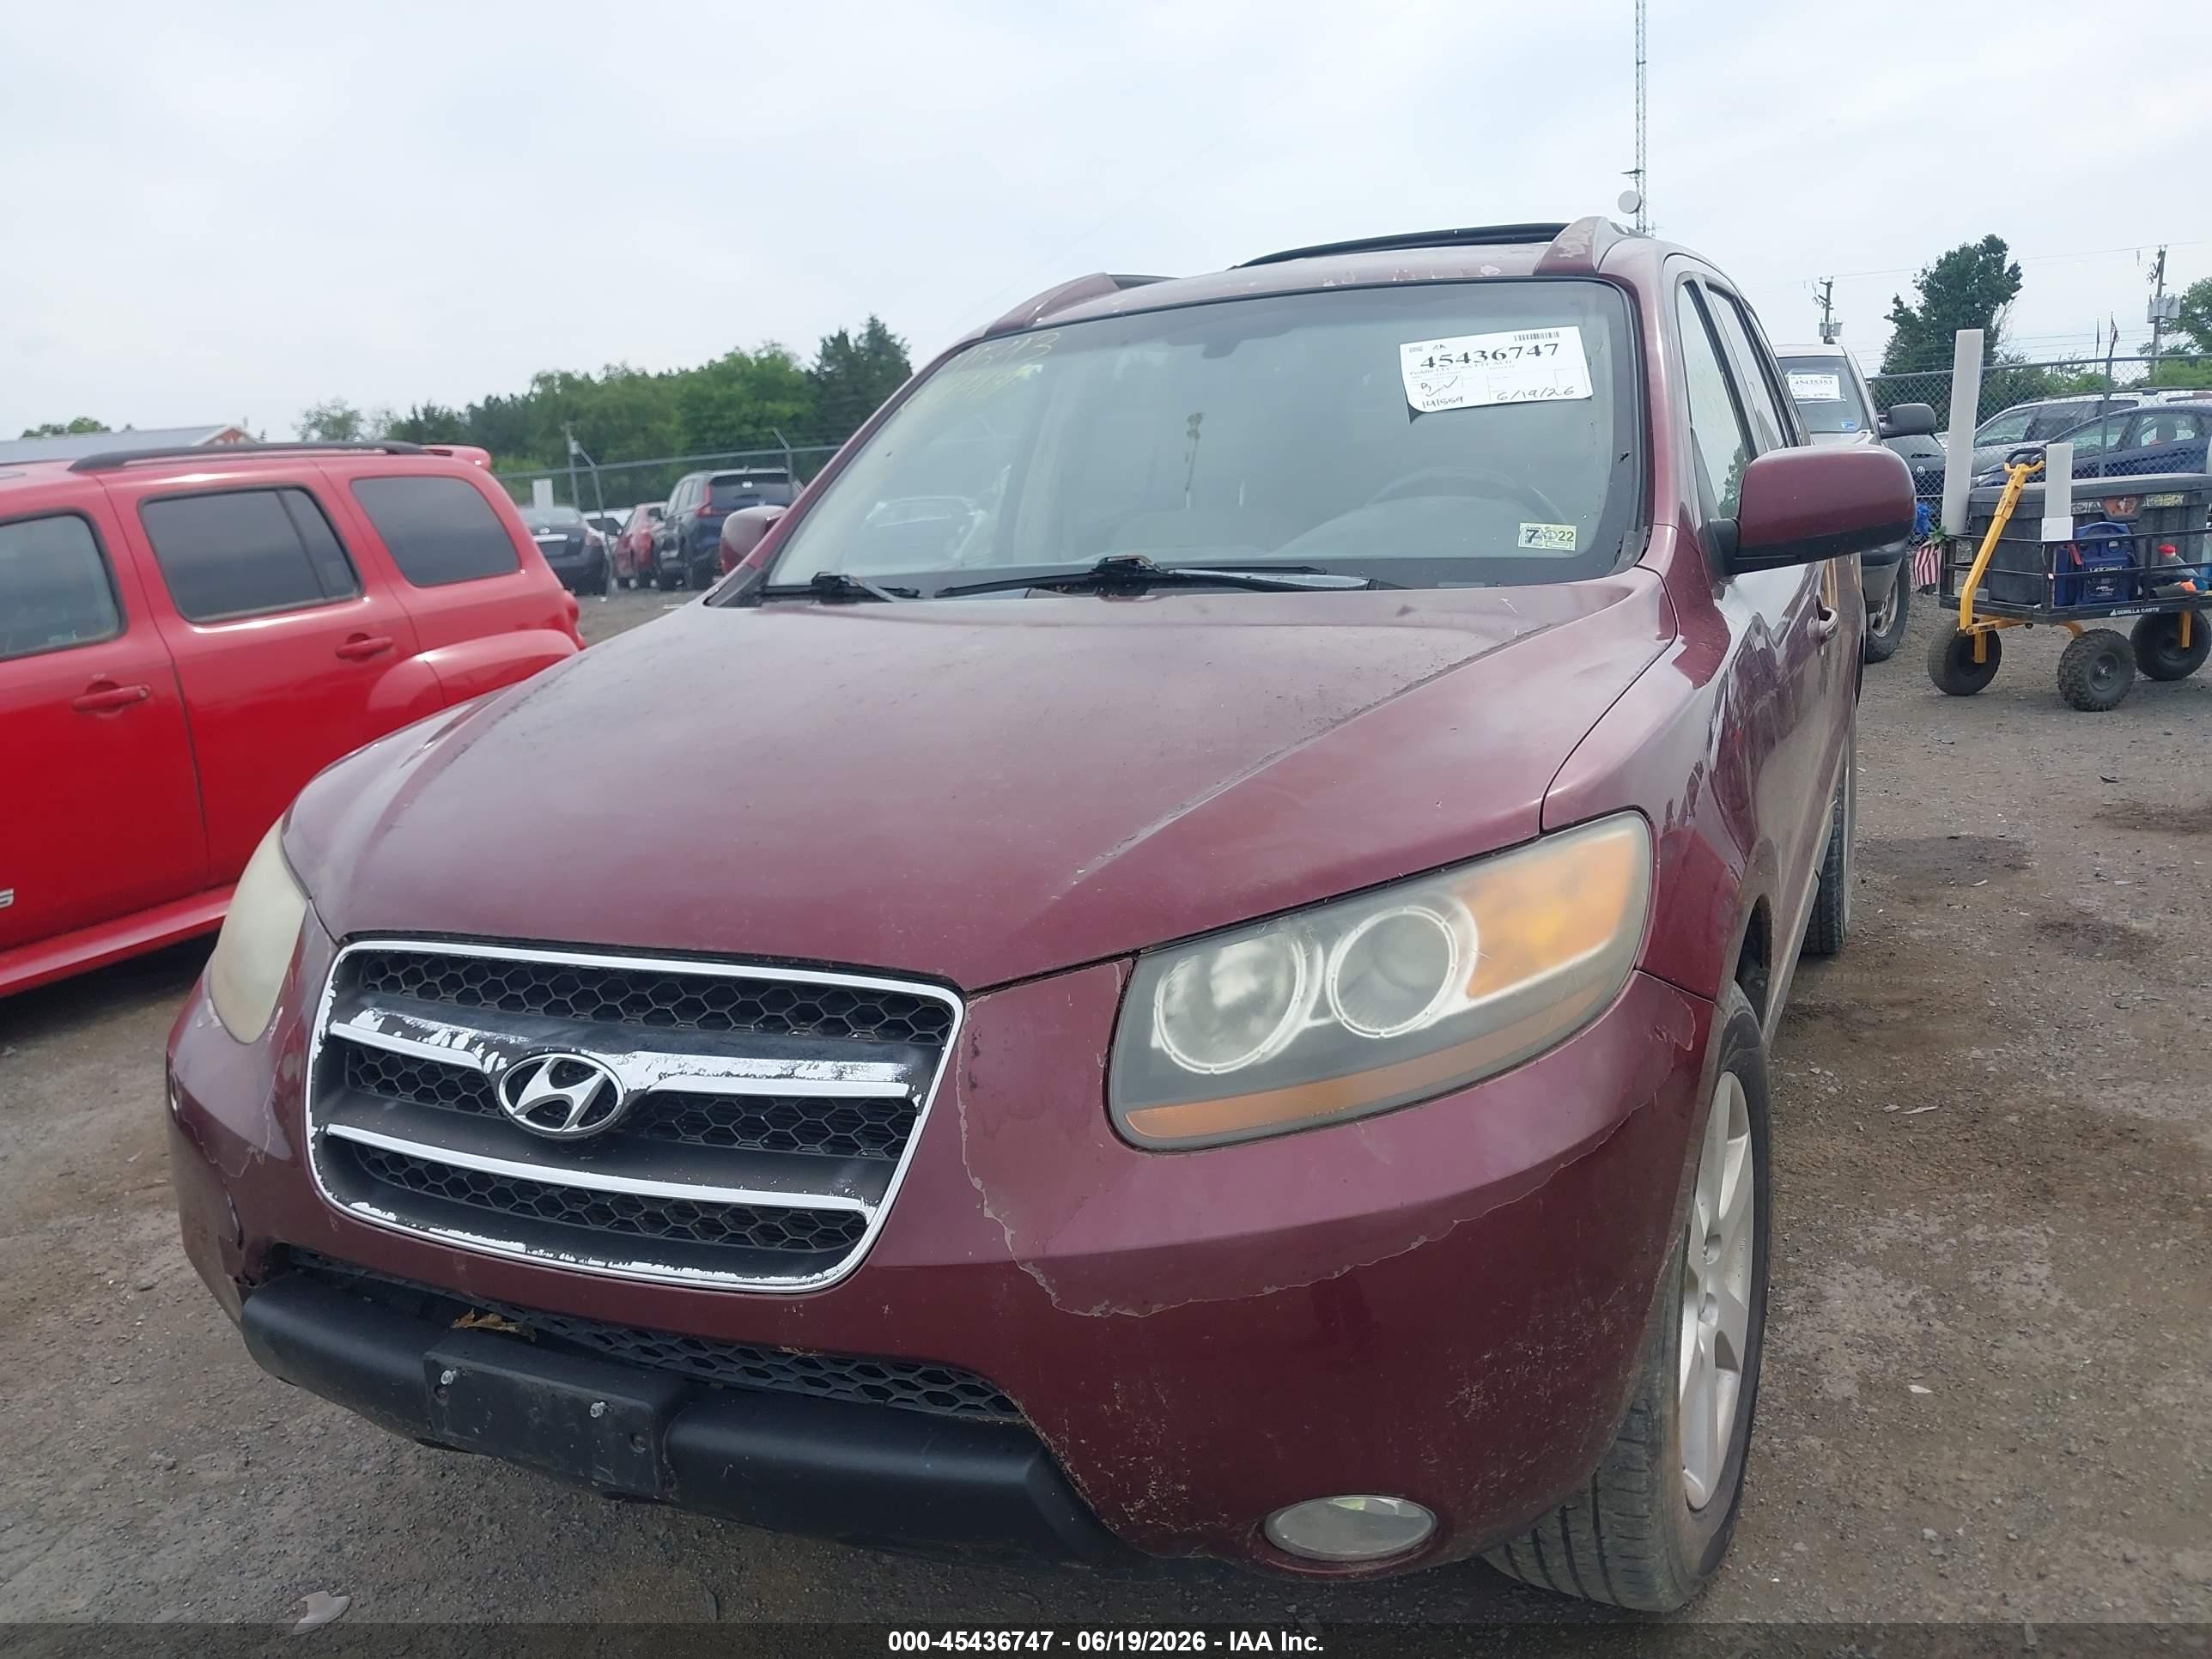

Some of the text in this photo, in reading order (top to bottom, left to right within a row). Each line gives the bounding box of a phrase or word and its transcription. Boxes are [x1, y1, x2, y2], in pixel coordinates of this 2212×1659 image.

[1419, 343, 1559, 368] 45436747
[1497, 386, 1575, 401] 6/19/26
[1526, 529, 1540, 544] 7
[1558, 530, 1575, 542] 22
